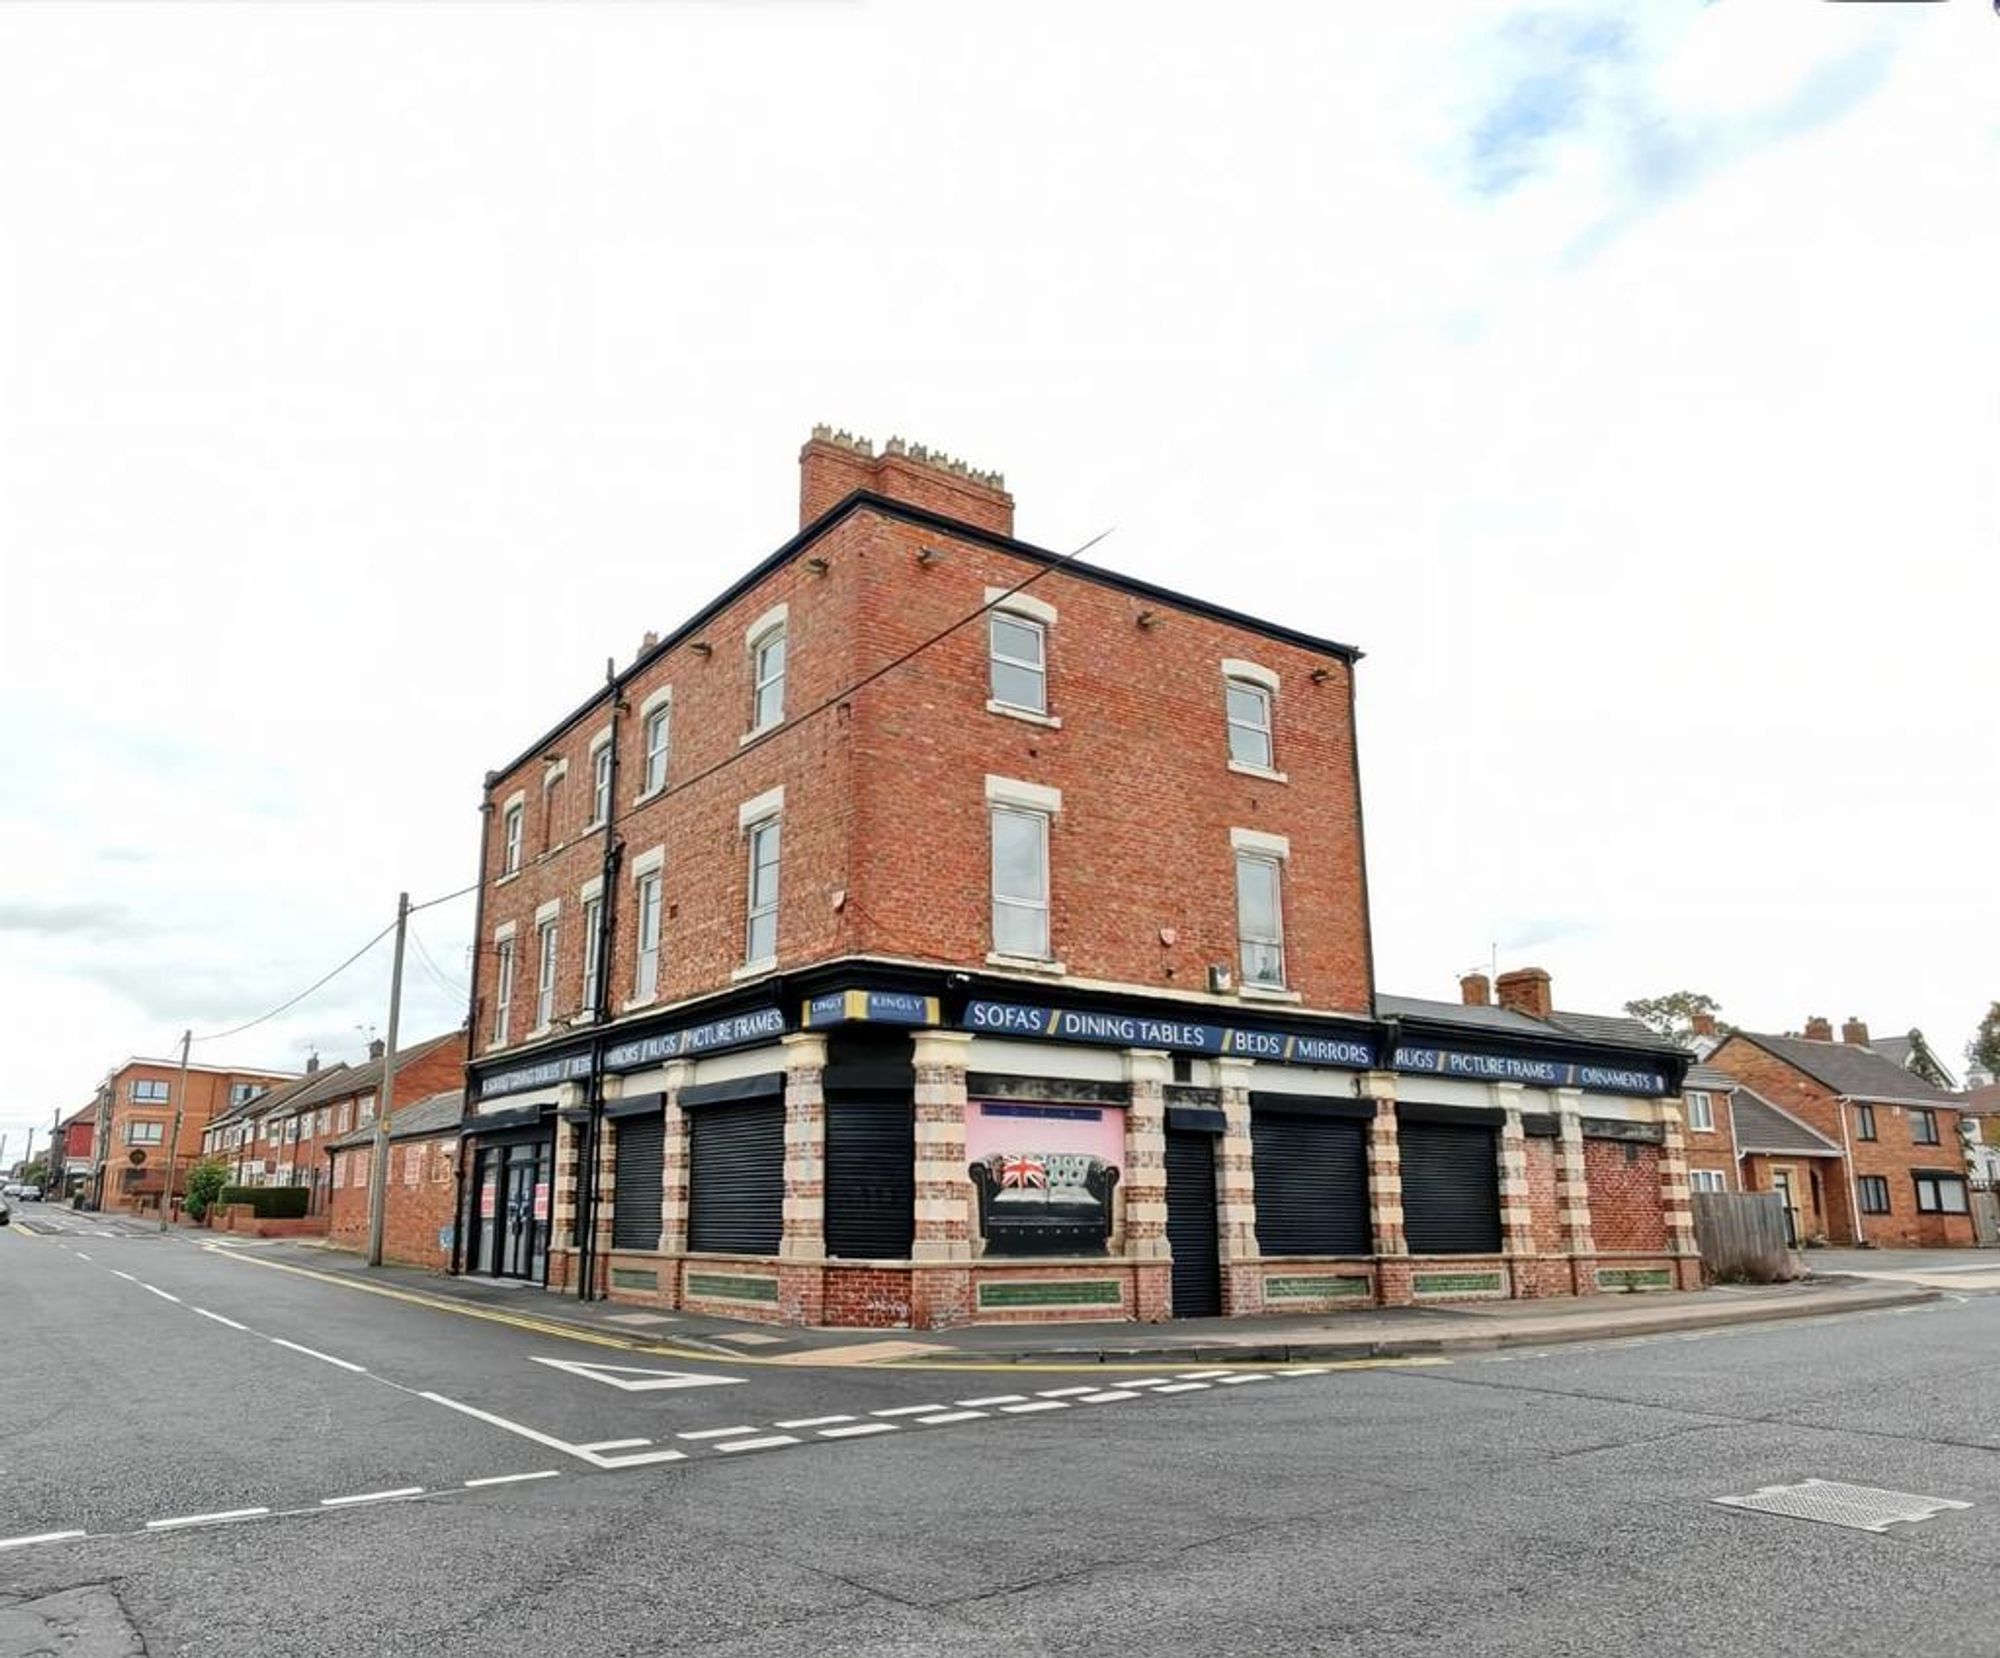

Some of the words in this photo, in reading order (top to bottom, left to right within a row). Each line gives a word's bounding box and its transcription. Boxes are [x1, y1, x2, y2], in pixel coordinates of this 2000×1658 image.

[871, 996, 922, 1011] KINGLY
[734, 1008, 783, 1039] FRAMES
[974, 1003, 1041, 1031] SOFAS
[1065, 1014, 1135, 1040] DINING
[1141, 1021, 1205, 1046] TABLES
[1235, 1031, 1280, 1054] BEDS
[1298, 1040, 1369, 1064] MIRRORS
[1395, 1048, 1433, 1068] RUGS
[1450, 1054, 1506, 1075] PICTURE
[1506, 1060, 1555, 1080] FRAMES
[1581, 1067, 1651, 1090] ORNAMENTS
